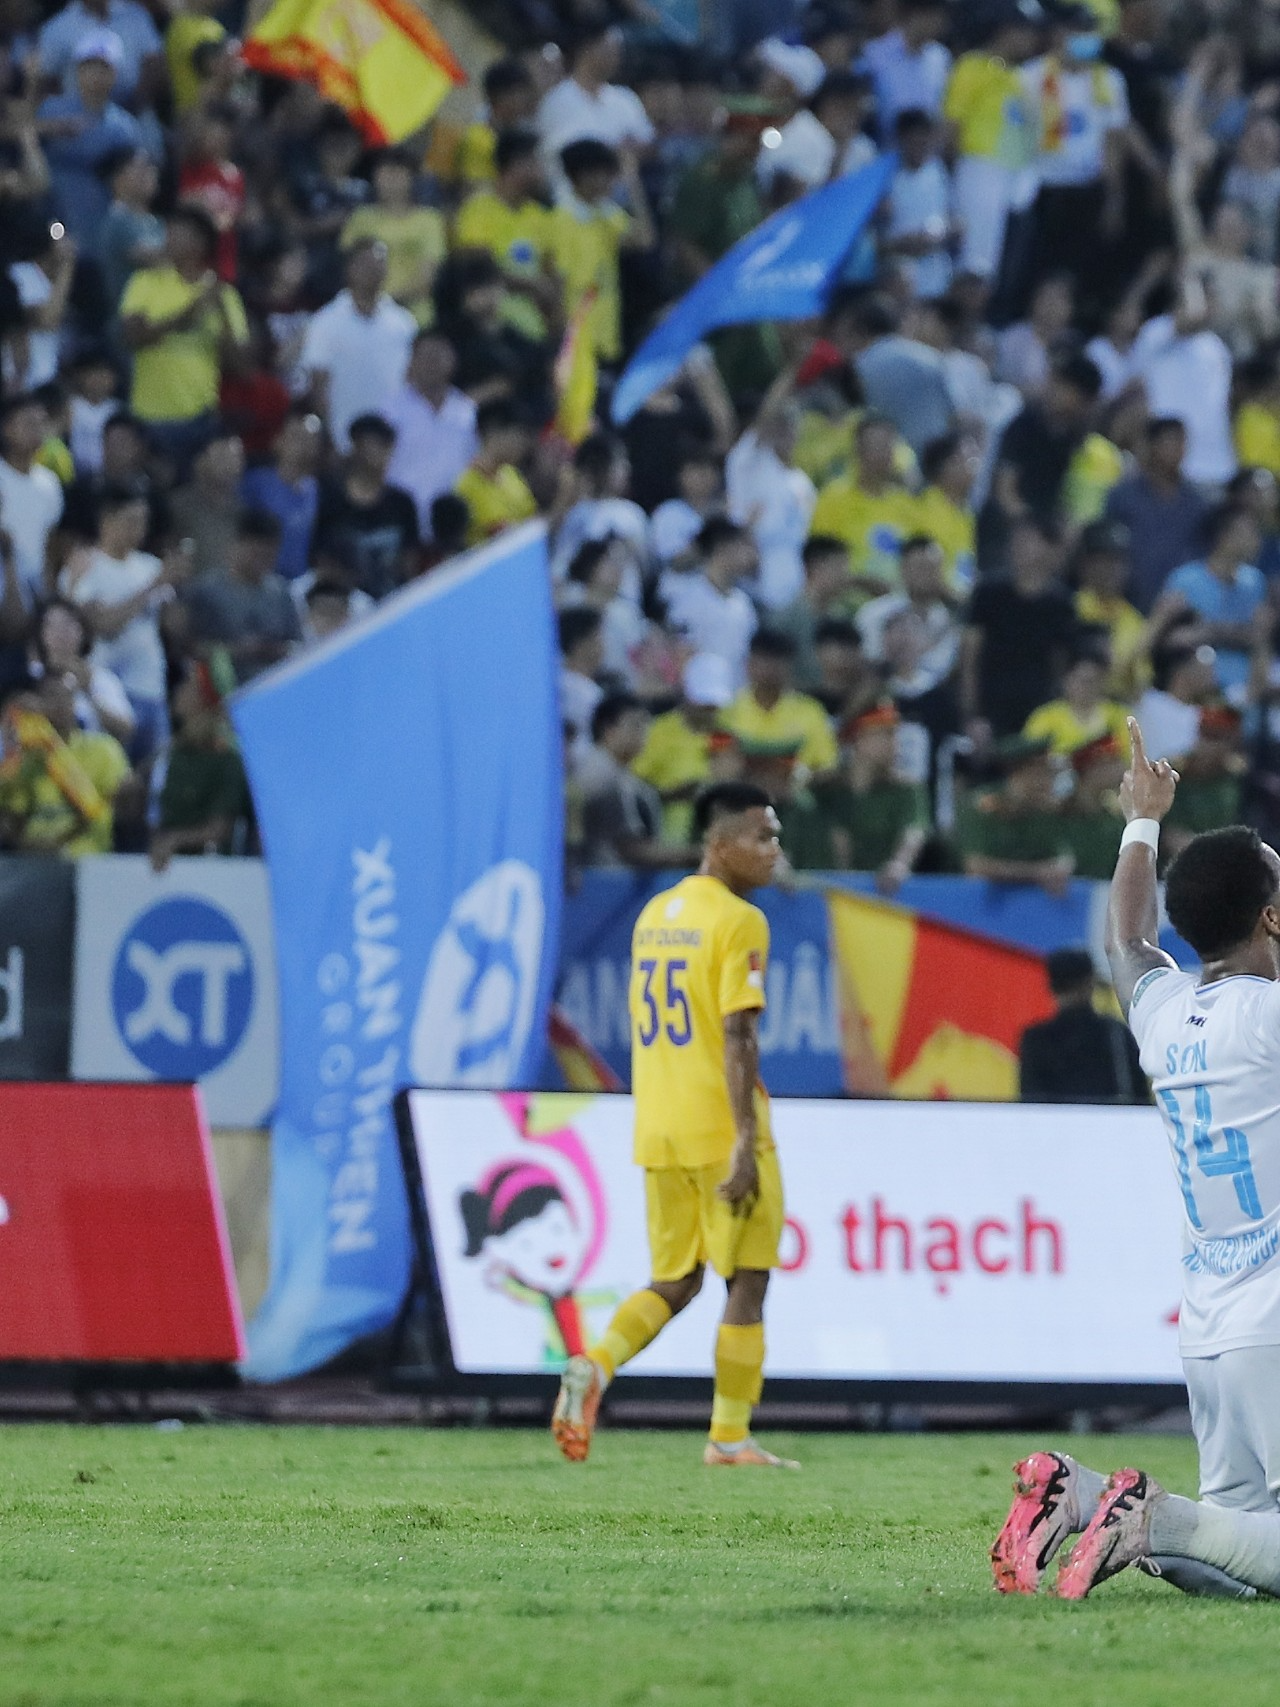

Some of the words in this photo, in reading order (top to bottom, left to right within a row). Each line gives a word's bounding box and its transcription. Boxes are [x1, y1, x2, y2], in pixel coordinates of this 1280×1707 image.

[126, 937, 245, 1048] XT
[639, 958, 692, 1047] 35
[1166, 1039, 1208, 1075] SON
[1159, 1085, 1264, 1230] 14
[839, 1194, 1068, 1296] thạch
